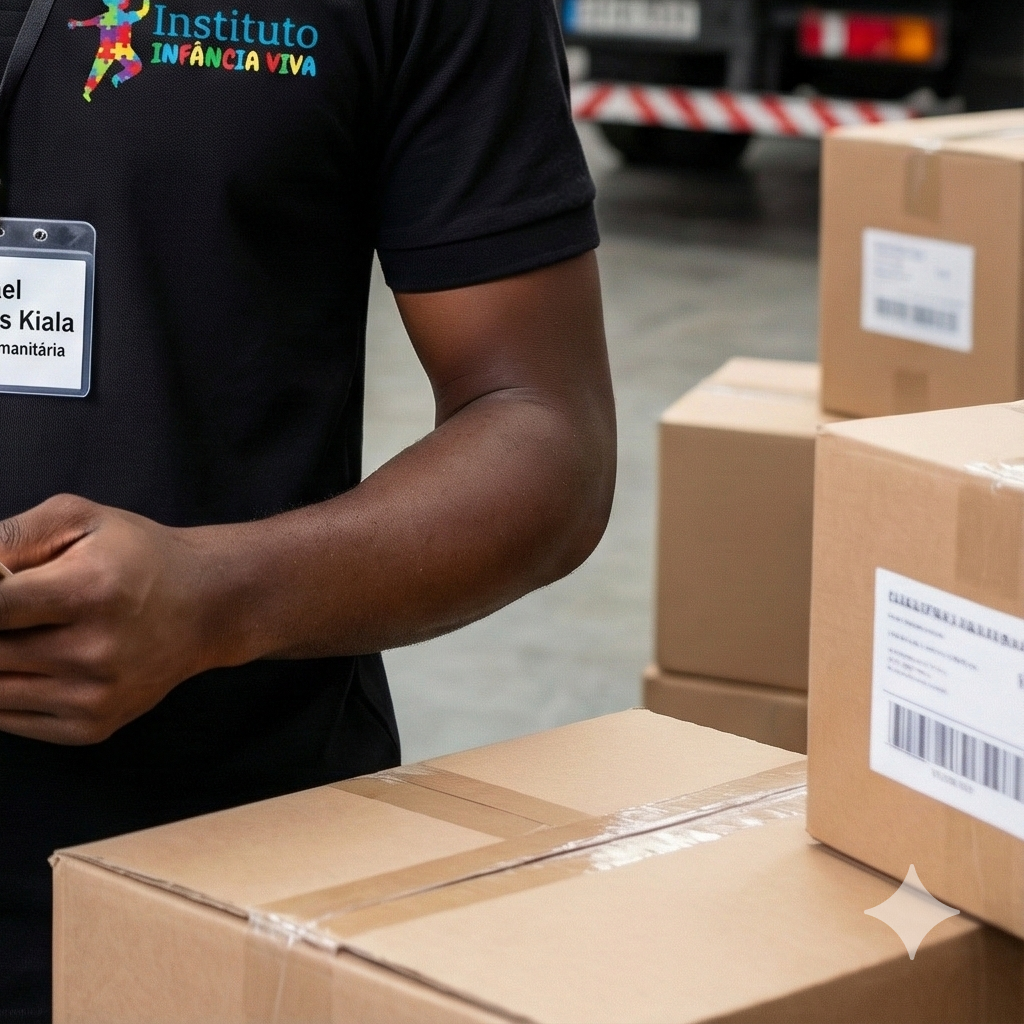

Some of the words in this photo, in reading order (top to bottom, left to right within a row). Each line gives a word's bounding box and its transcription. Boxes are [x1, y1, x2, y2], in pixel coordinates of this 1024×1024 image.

[152, 4, 318, 48] Instituto
[150, 42, 259, 71] INFÂNCIA
[267, 53, 316, 76] VIVA
[19, 309, 74, 333] Kiala
